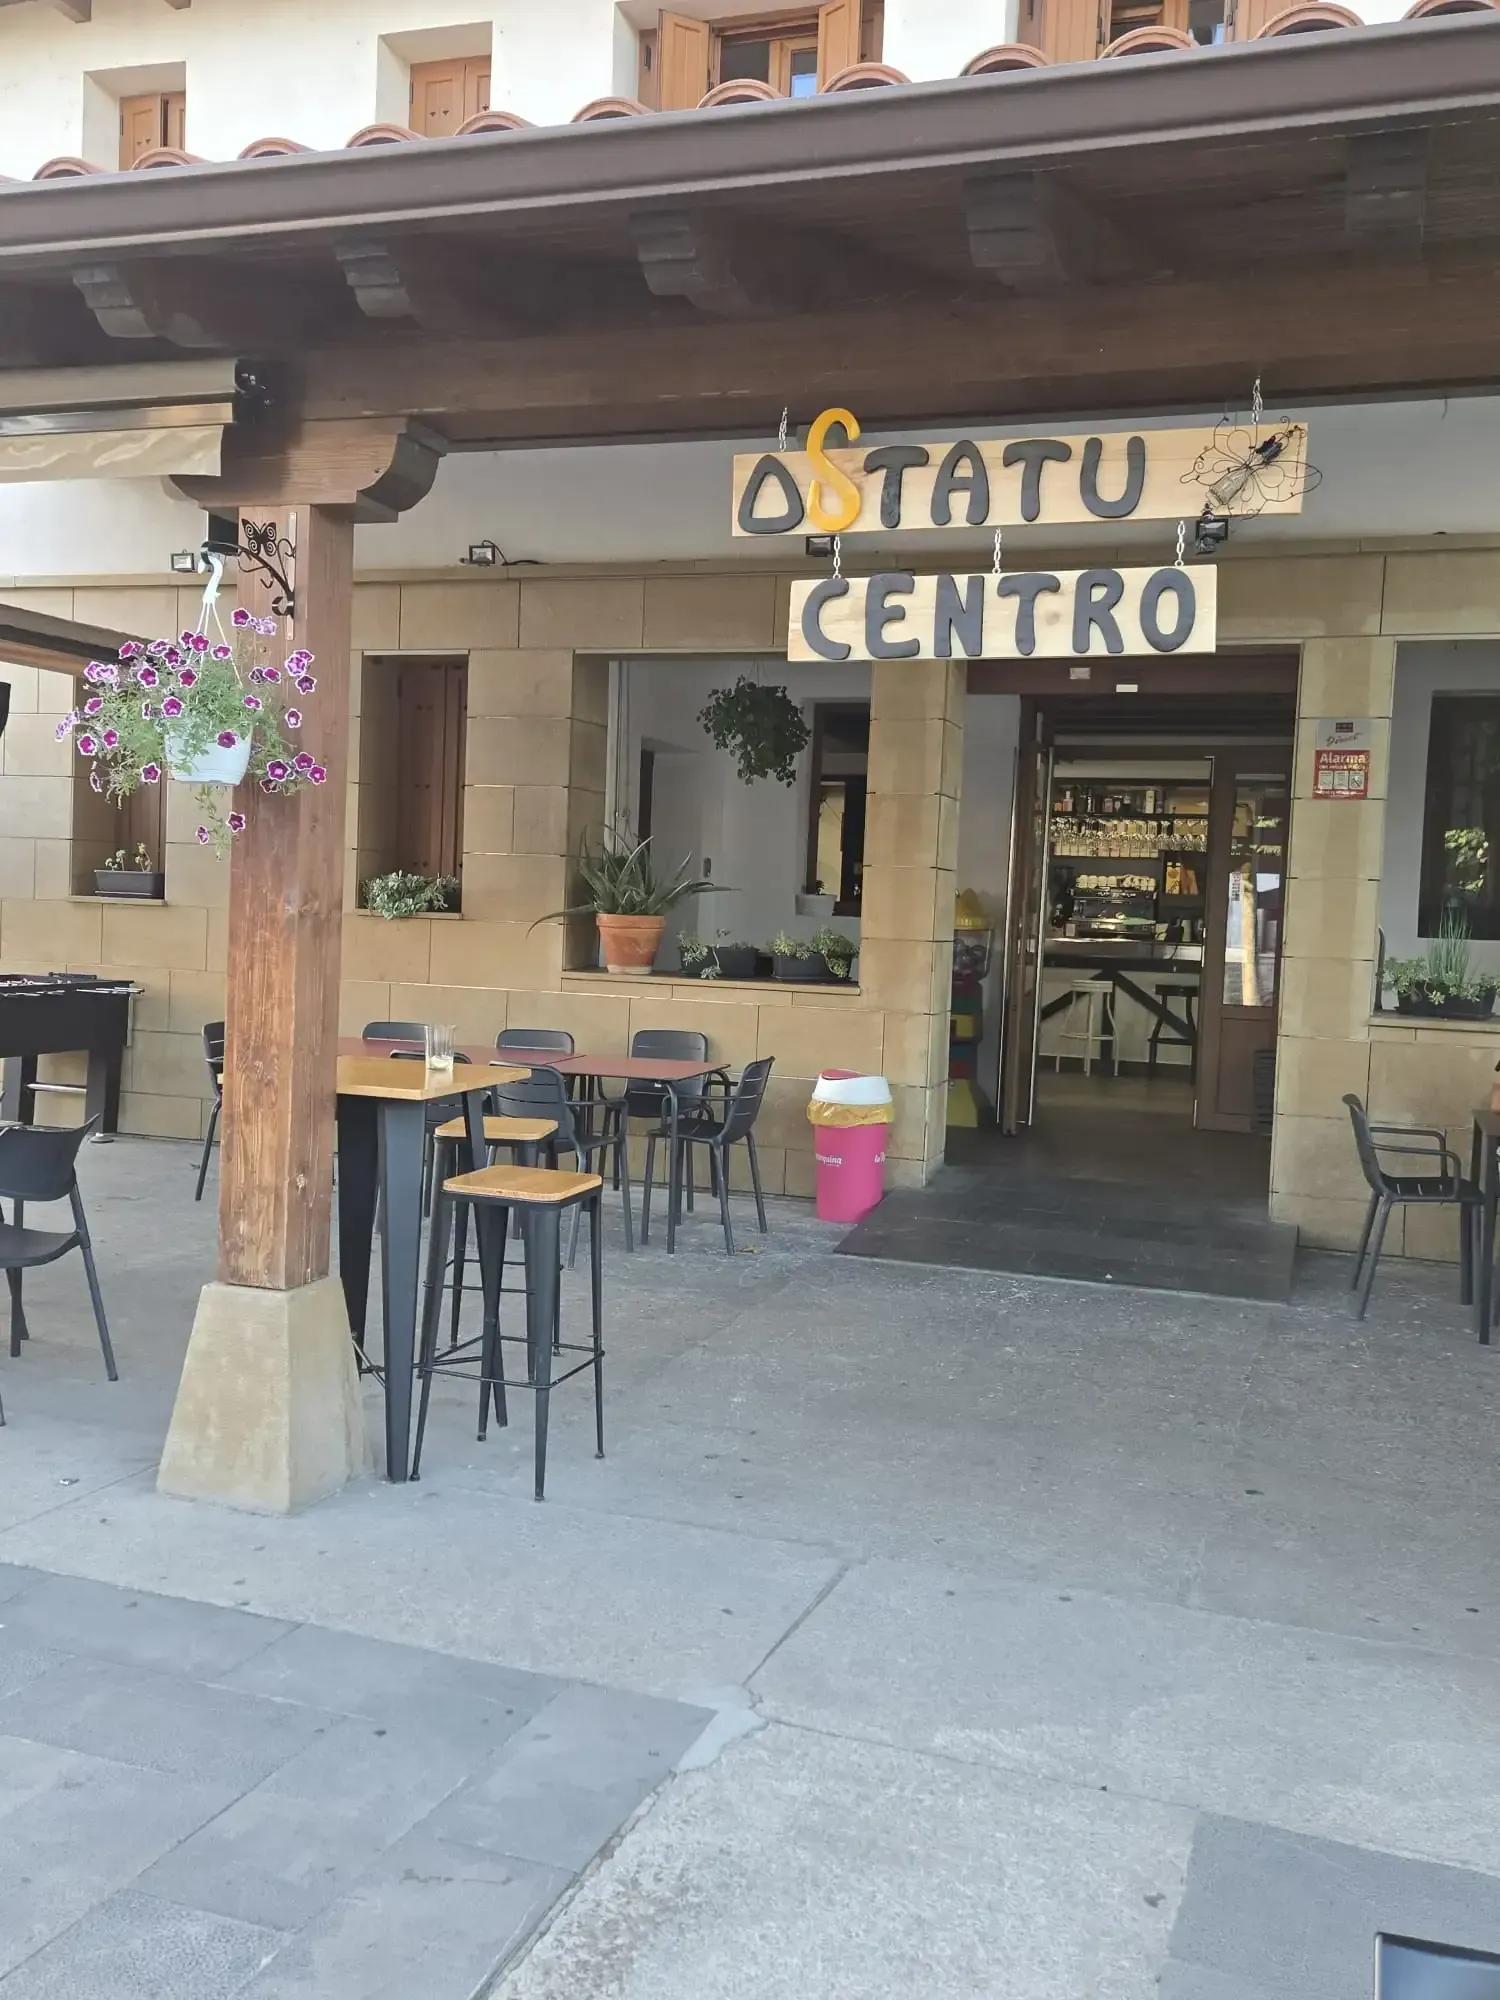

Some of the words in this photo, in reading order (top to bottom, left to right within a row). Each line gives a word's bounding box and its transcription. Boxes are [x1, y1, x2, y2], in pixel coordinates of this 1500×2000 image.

[738, 407, 1146, 534] OSTATU
[801, 567, 1197, 661] CENTRO
[1319, 751, 1366, 764] Alarma
